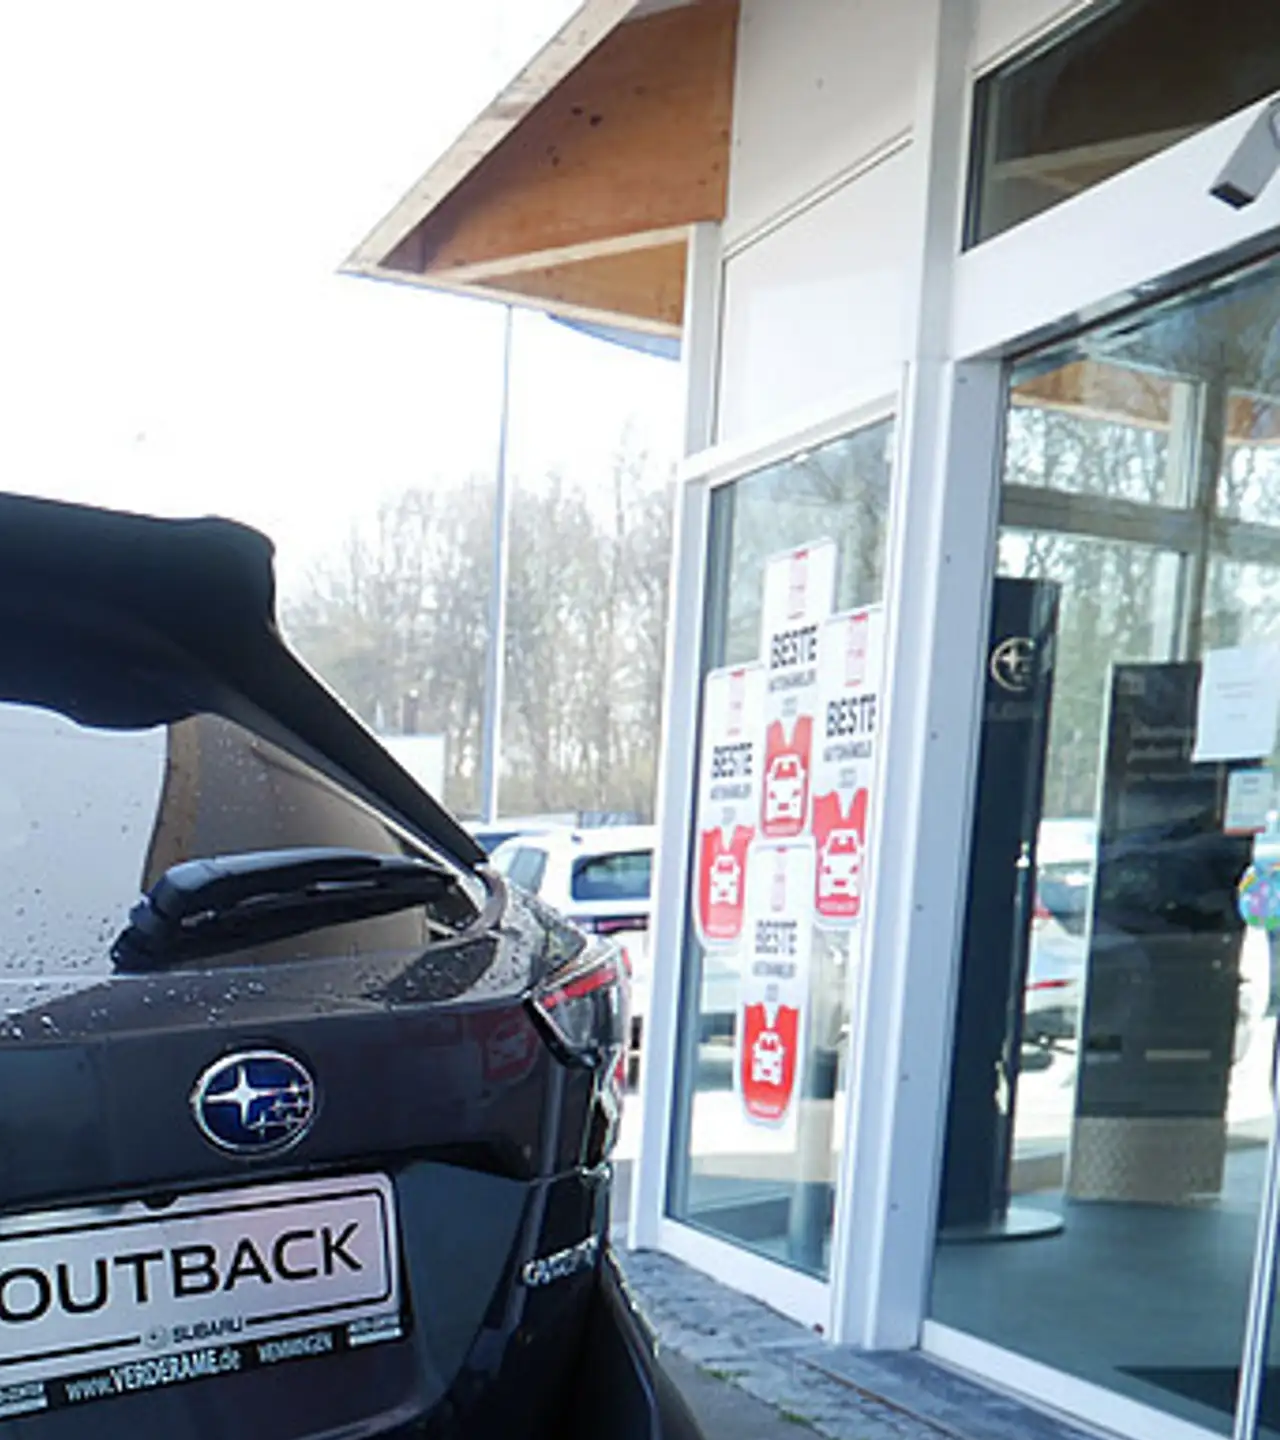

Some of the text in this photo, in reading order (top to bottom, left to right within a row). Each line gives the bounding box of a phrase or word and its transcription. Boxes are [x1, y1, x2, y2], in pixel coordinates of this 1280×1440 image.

[773, 624, 818, 669] BESTE
[827, 693, 876, 737] BESTE
[712, 742, 753, 779] BESTE
[172, 1316, 244, 1344] SUBARU
